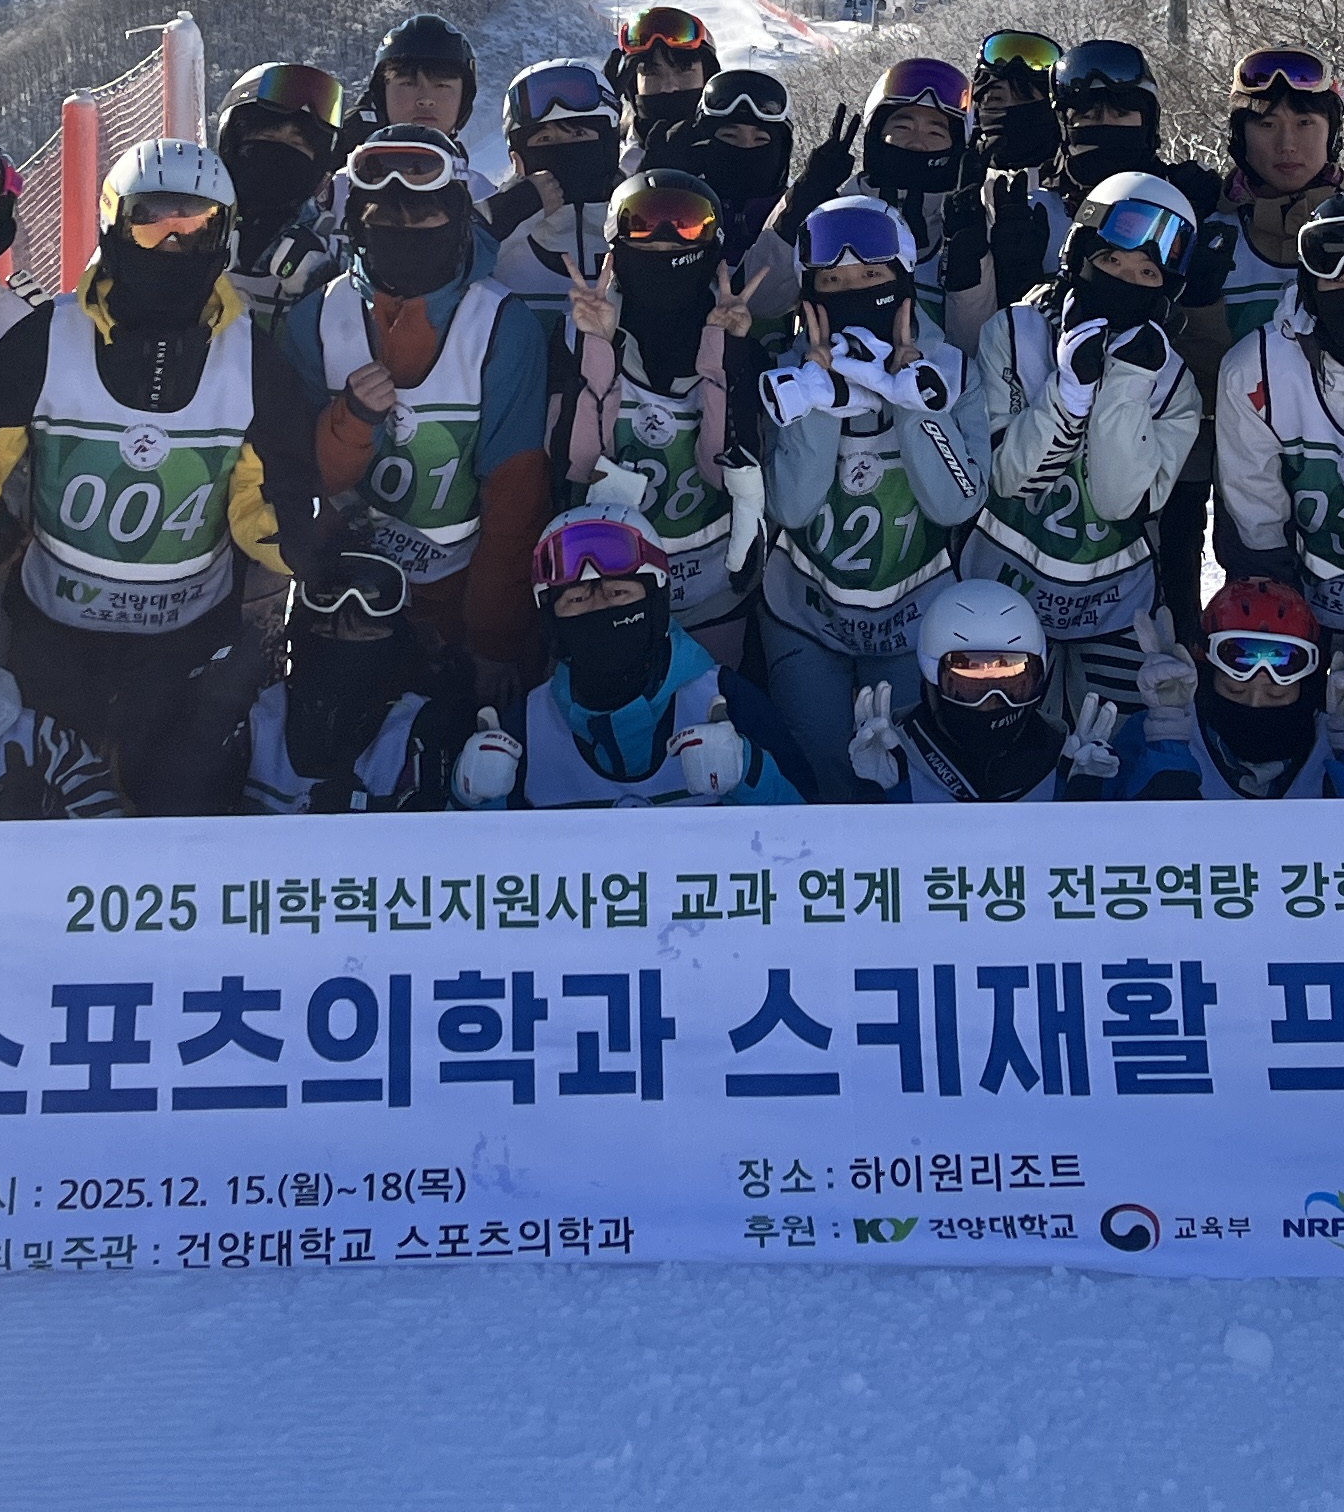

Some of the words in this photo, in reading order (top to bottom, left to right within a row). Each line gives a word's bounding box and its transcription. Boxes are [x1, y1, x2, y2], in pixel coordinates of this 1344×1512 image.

[60, 473, 215, 544] 004
[370, 455, 460, 510] 01
[806, 504, 921, 571] 021
[925, 751, 957, 785] MAKE
[66, 884, 198, 933] 2025
[222, 871, 649, 936] 대학혁신지원사업
[671, 869, 777, 925] 교과
[798, 865, 902, 924] 연계
[924, 863, 1027, 922] 학생
[1047, 863, 1259, 922] 전공역량
[725, 958, 1218, 1099] 스키재활
[57, 1178, 209, 1211] 2025.12.
[226, 1165, 467, 1208] 15.(월)~18(목)
[738, 1157, 816, 1199] 장소
[849, 1152, 1086, 1195] 하이원리조트
[177, 1226, 376, 1271] 건양대학교
[394, 1216, 635, 1263] 스포츠의학과
[743, 1214, 817, 1249] 후원
[928, 1212, 1080, 1240] 건양대학교
[1173, 1214, 1253, 1242] 교육부
